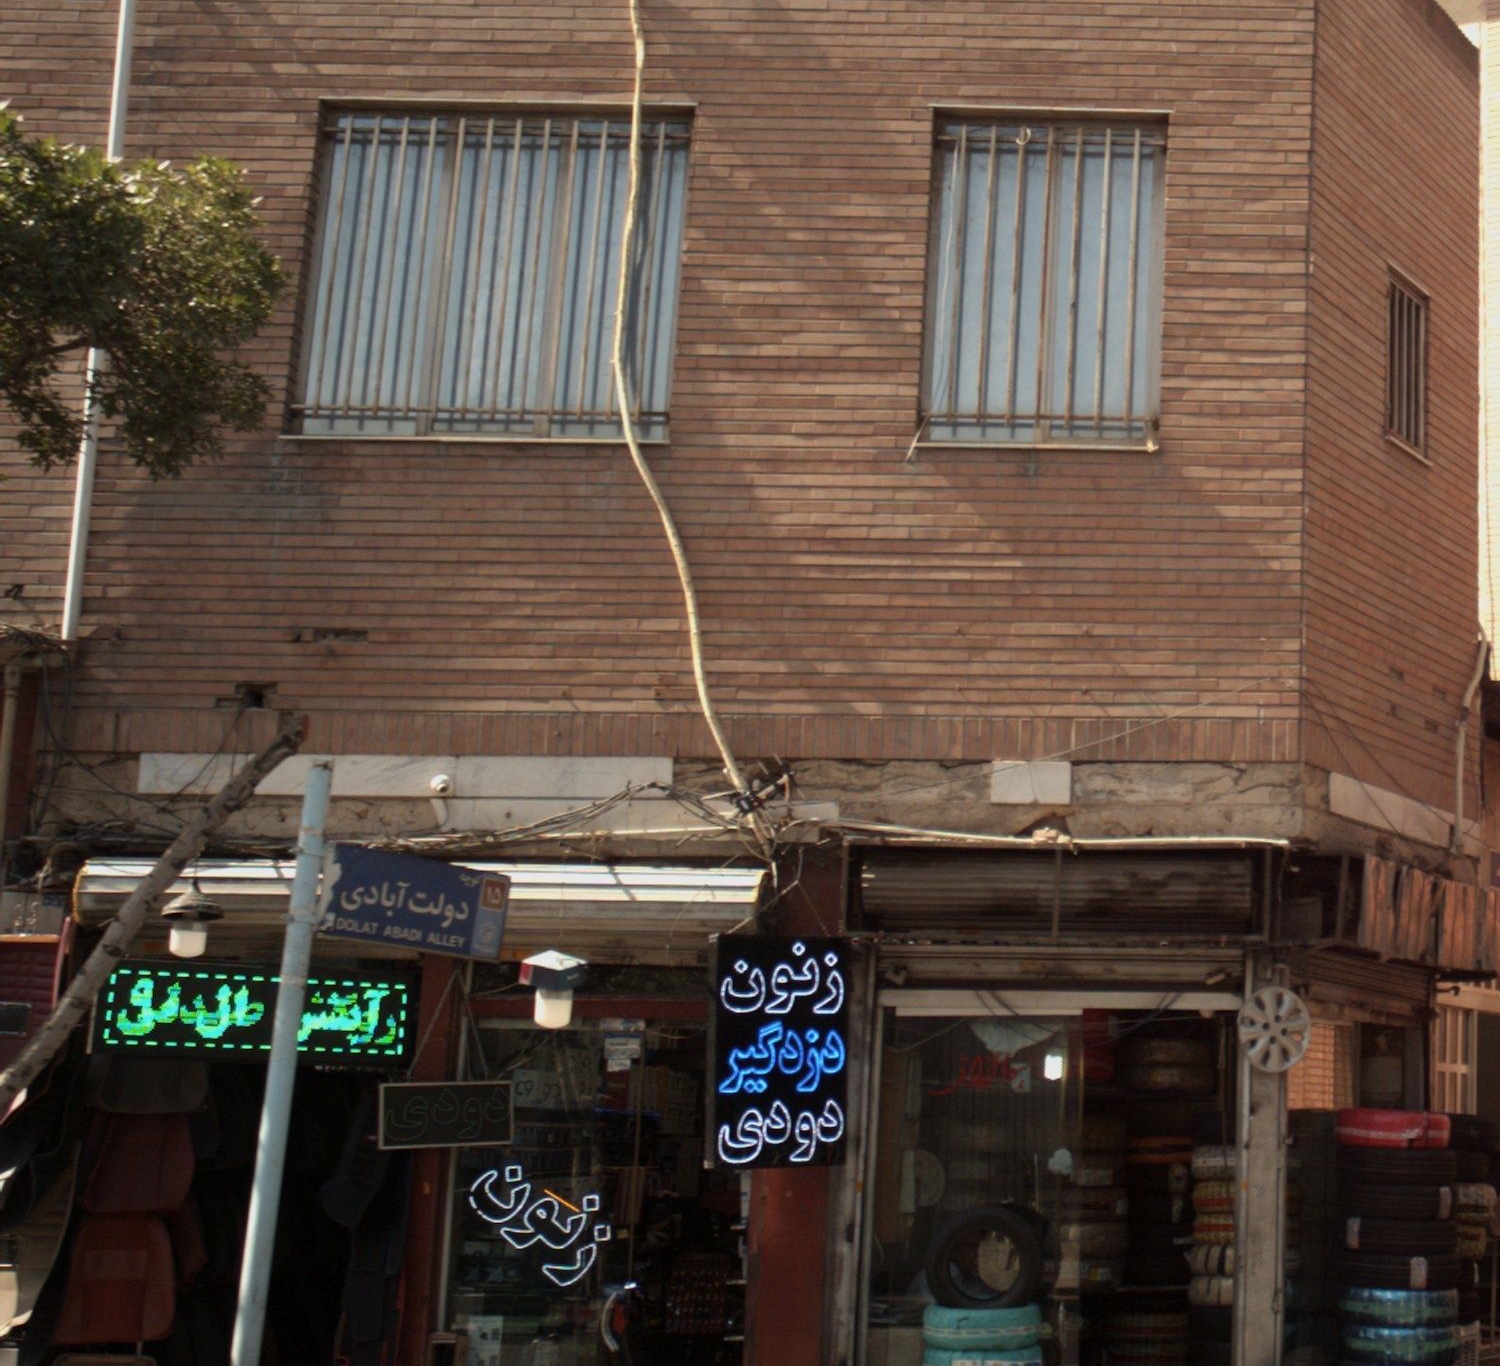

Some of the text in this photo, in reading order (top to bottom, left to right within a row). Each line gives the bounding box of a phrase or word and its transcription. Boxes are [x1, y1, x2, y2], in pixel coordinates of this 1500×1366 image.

[336, 917, 466, 949] DOLAT ABADI ALLEY
[340, 881, 470, 928] دولت آبادی
[720, 942, 845, 1014] زنون
[718, 1020, 846, 1093] دزدگیر
[385, 1088, 512, 1141] دودی
[718, 1099, 845, 1164] دودی
[469, 1165, 612, 1287] زنون
